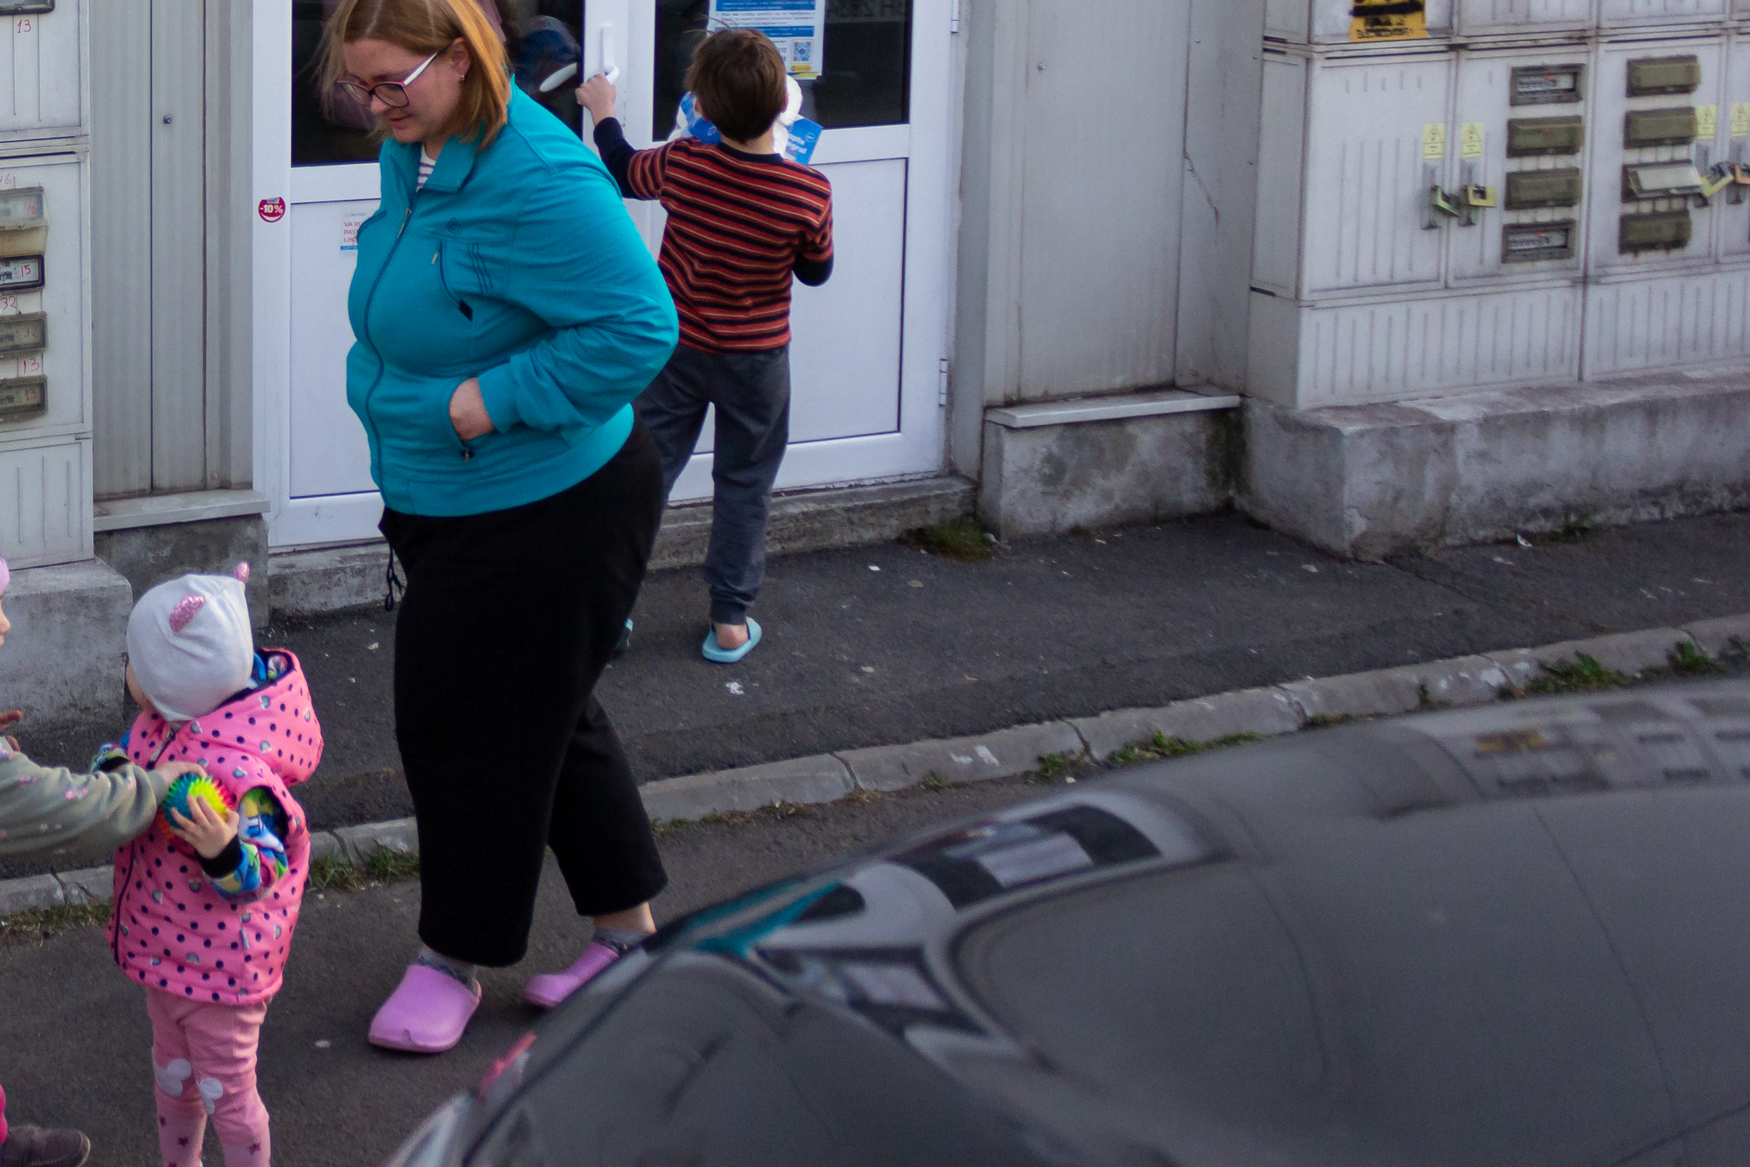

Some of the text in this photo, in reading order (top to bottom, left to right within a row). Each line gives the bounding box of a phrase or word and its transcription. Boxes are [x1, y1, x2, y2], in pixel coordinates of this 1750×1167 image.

[17, 19, 32, 34] 13
[259, 204, 284, 214] -10%
[21, 264, 32, 277] 15
[0, 295, 17, 310] 32
[23, 357, 40, 374] 13
